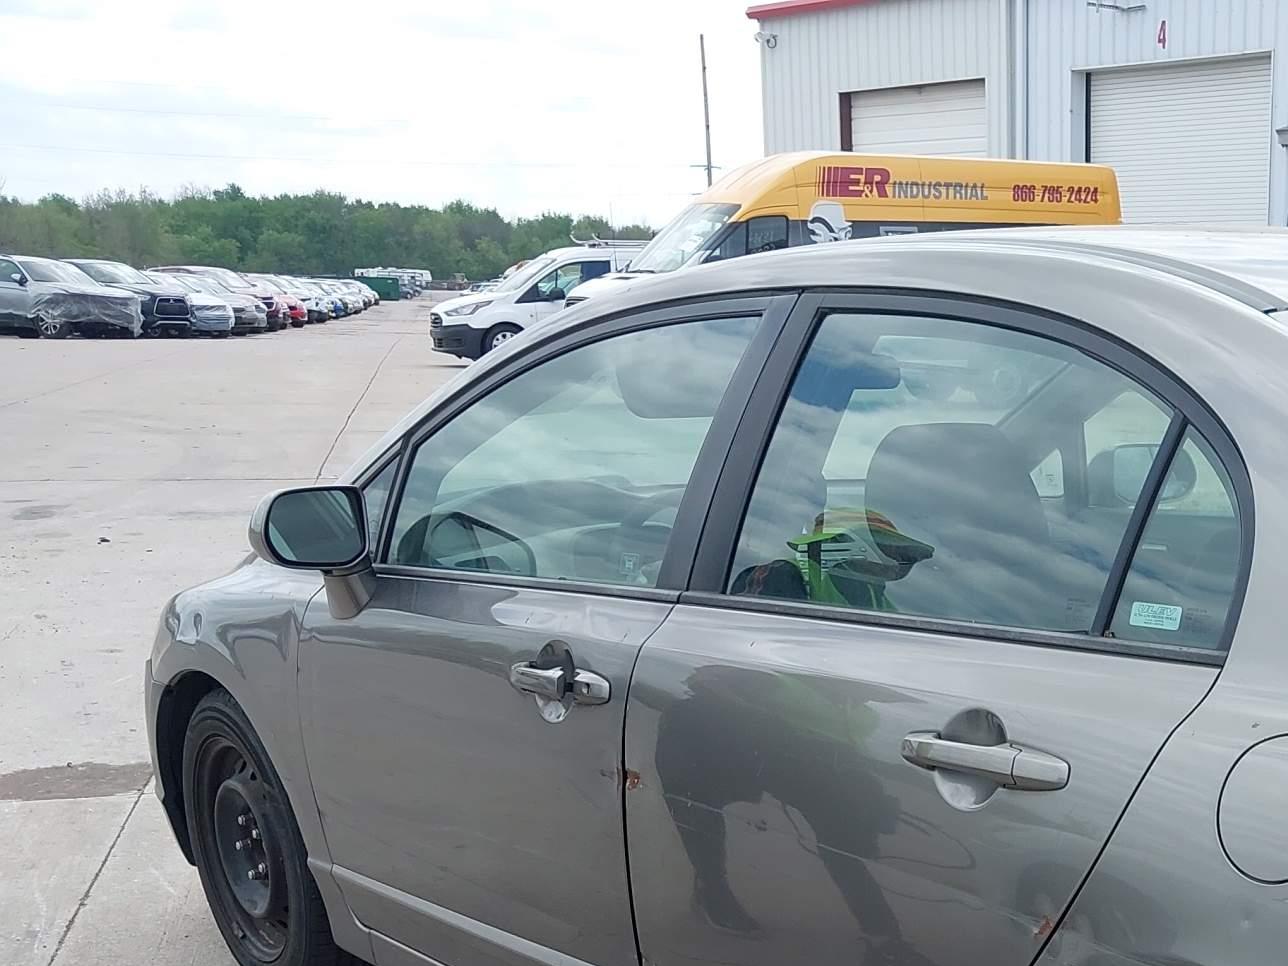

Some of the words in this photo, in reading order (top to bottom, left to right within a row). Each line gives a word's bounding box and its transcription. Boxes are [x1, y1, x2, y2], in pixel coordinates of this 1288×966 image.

[1157, 20, 1167, 49] 4
[892, 180, 989, 201] INDUSTRIAL
[1012, 184, 1099, 204] 866-795-2424
